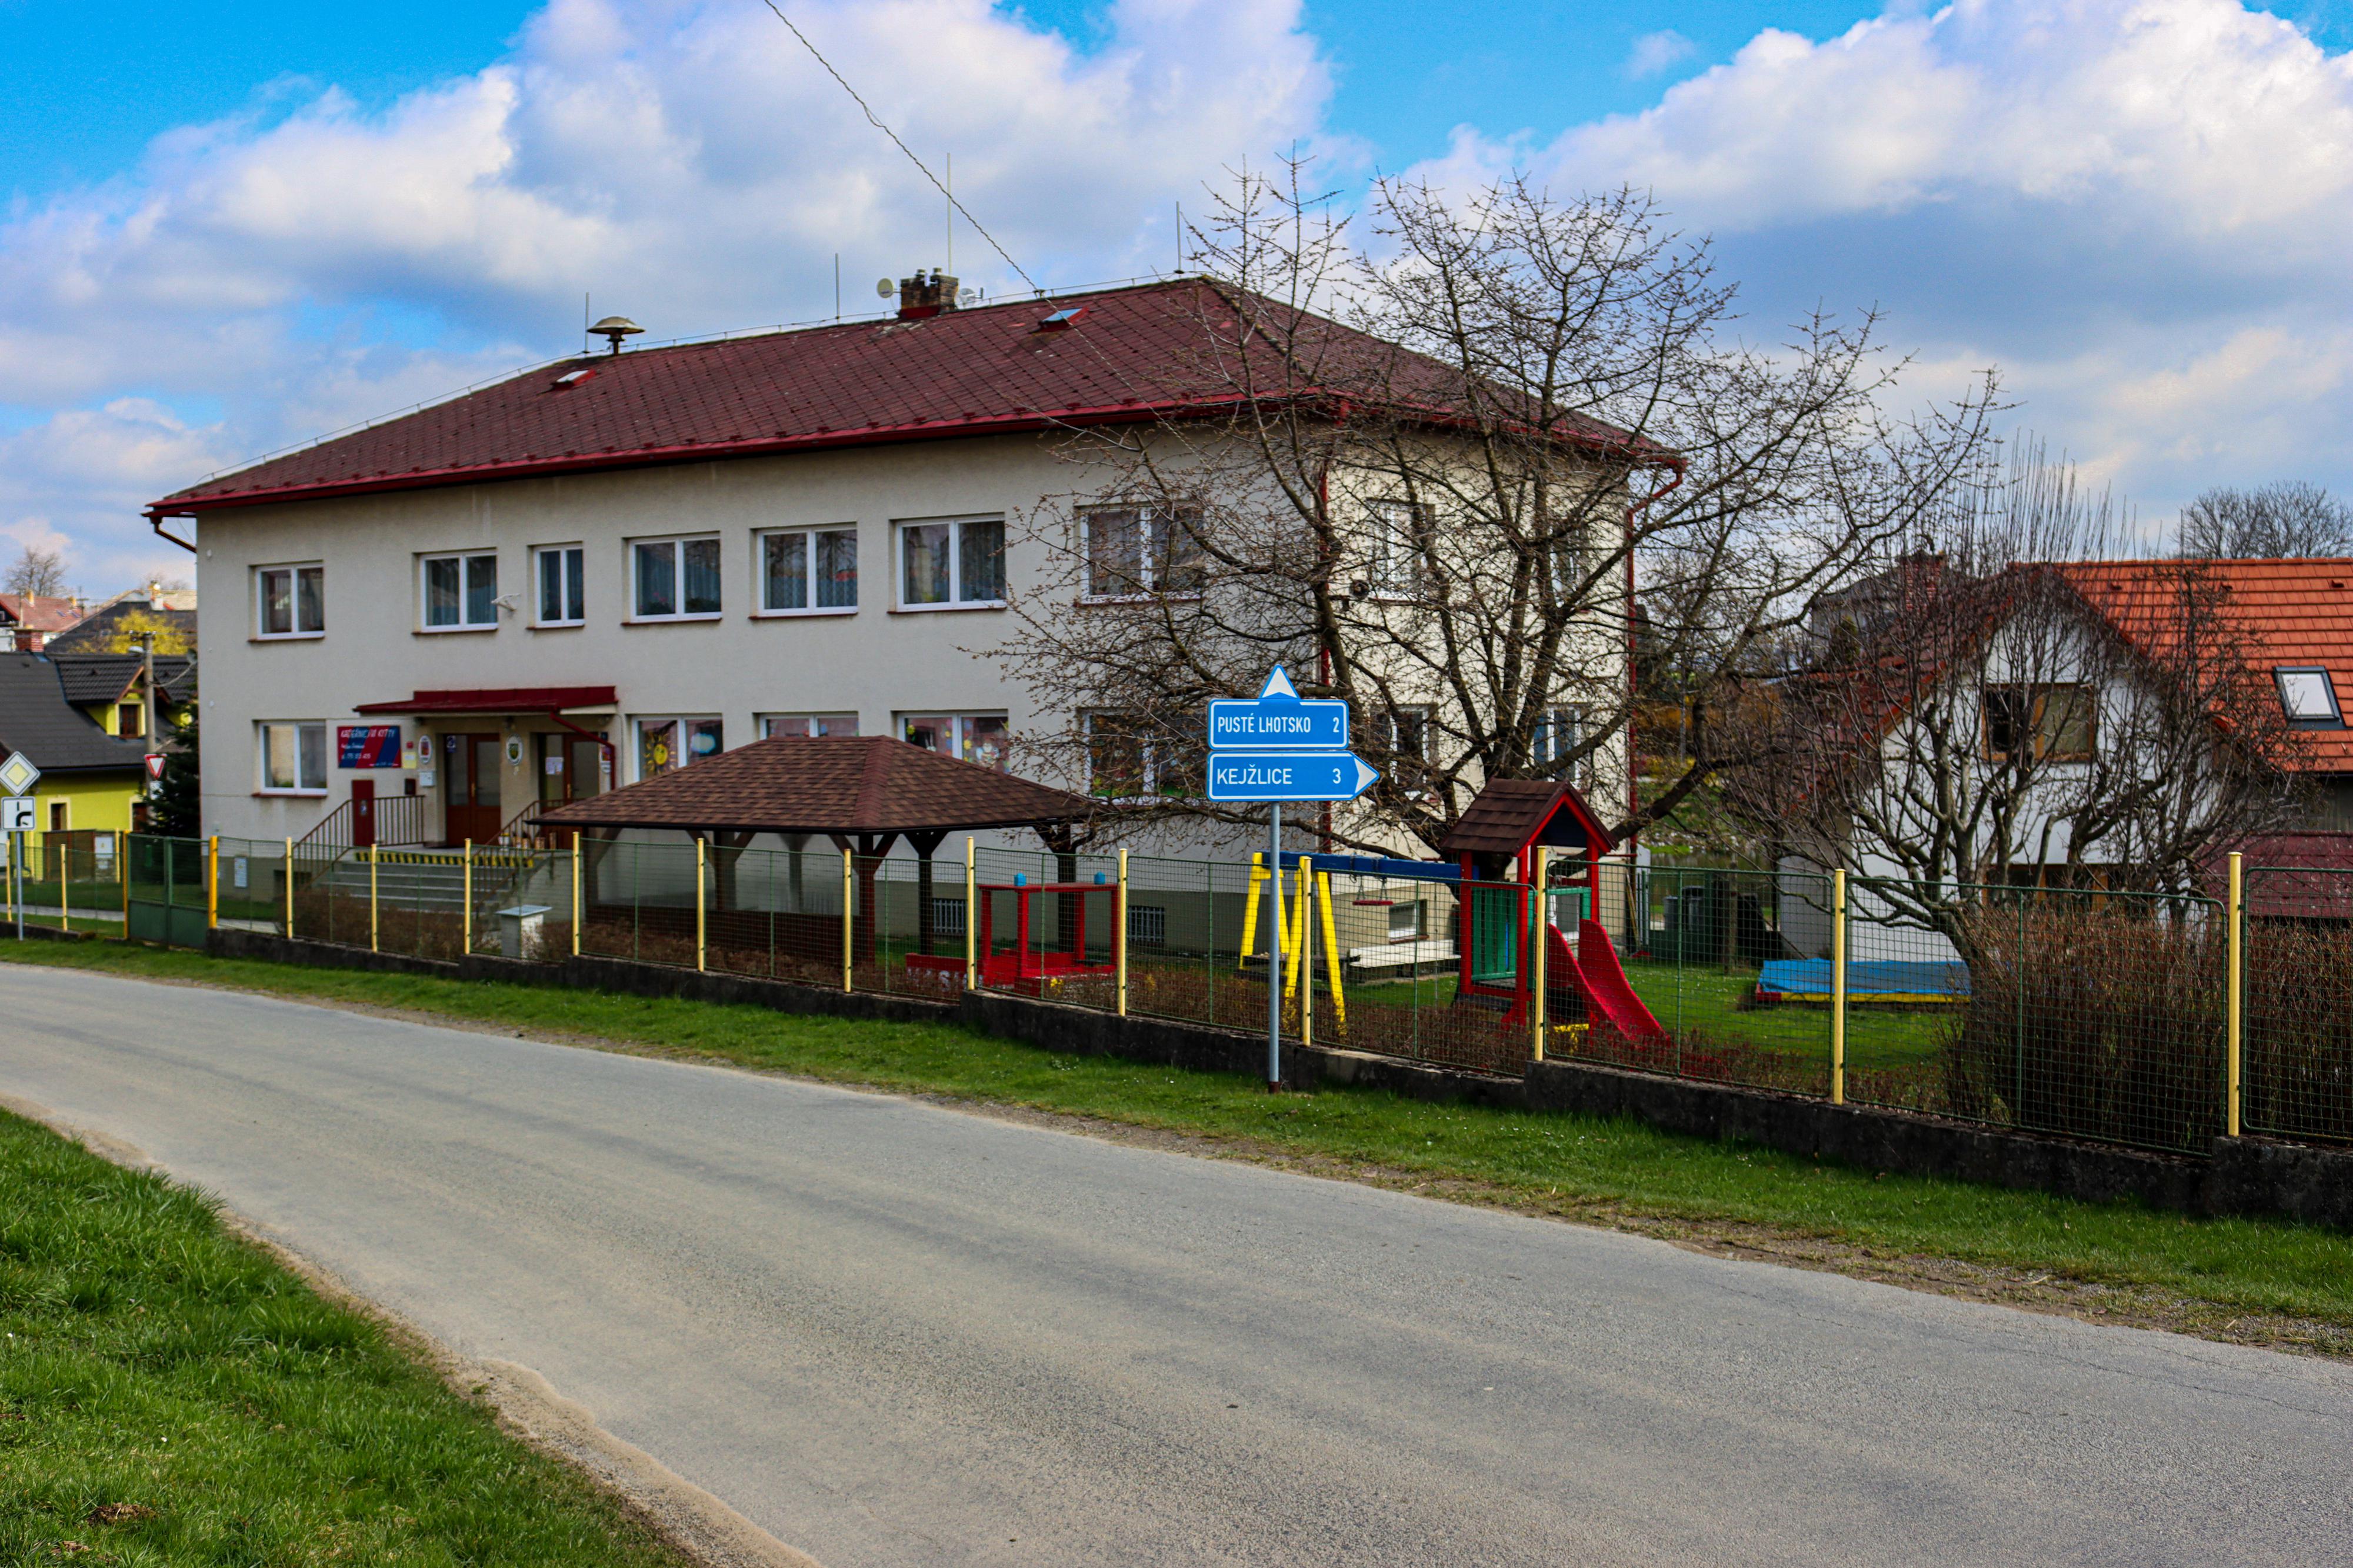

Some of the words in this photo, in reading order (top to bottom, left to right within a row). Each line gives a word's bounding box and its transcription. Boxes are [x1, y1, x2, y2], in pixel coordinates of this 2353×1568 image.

[1218, 713, 1254, 733] PUSTÉ
[1259, 716, 1311, 733] LHOTSKO
[1332, 717, 1339, 733] 2
[1217, 764, 1292, 785] KEJŽLICE
[1332, 768, 1341, 784] 3
